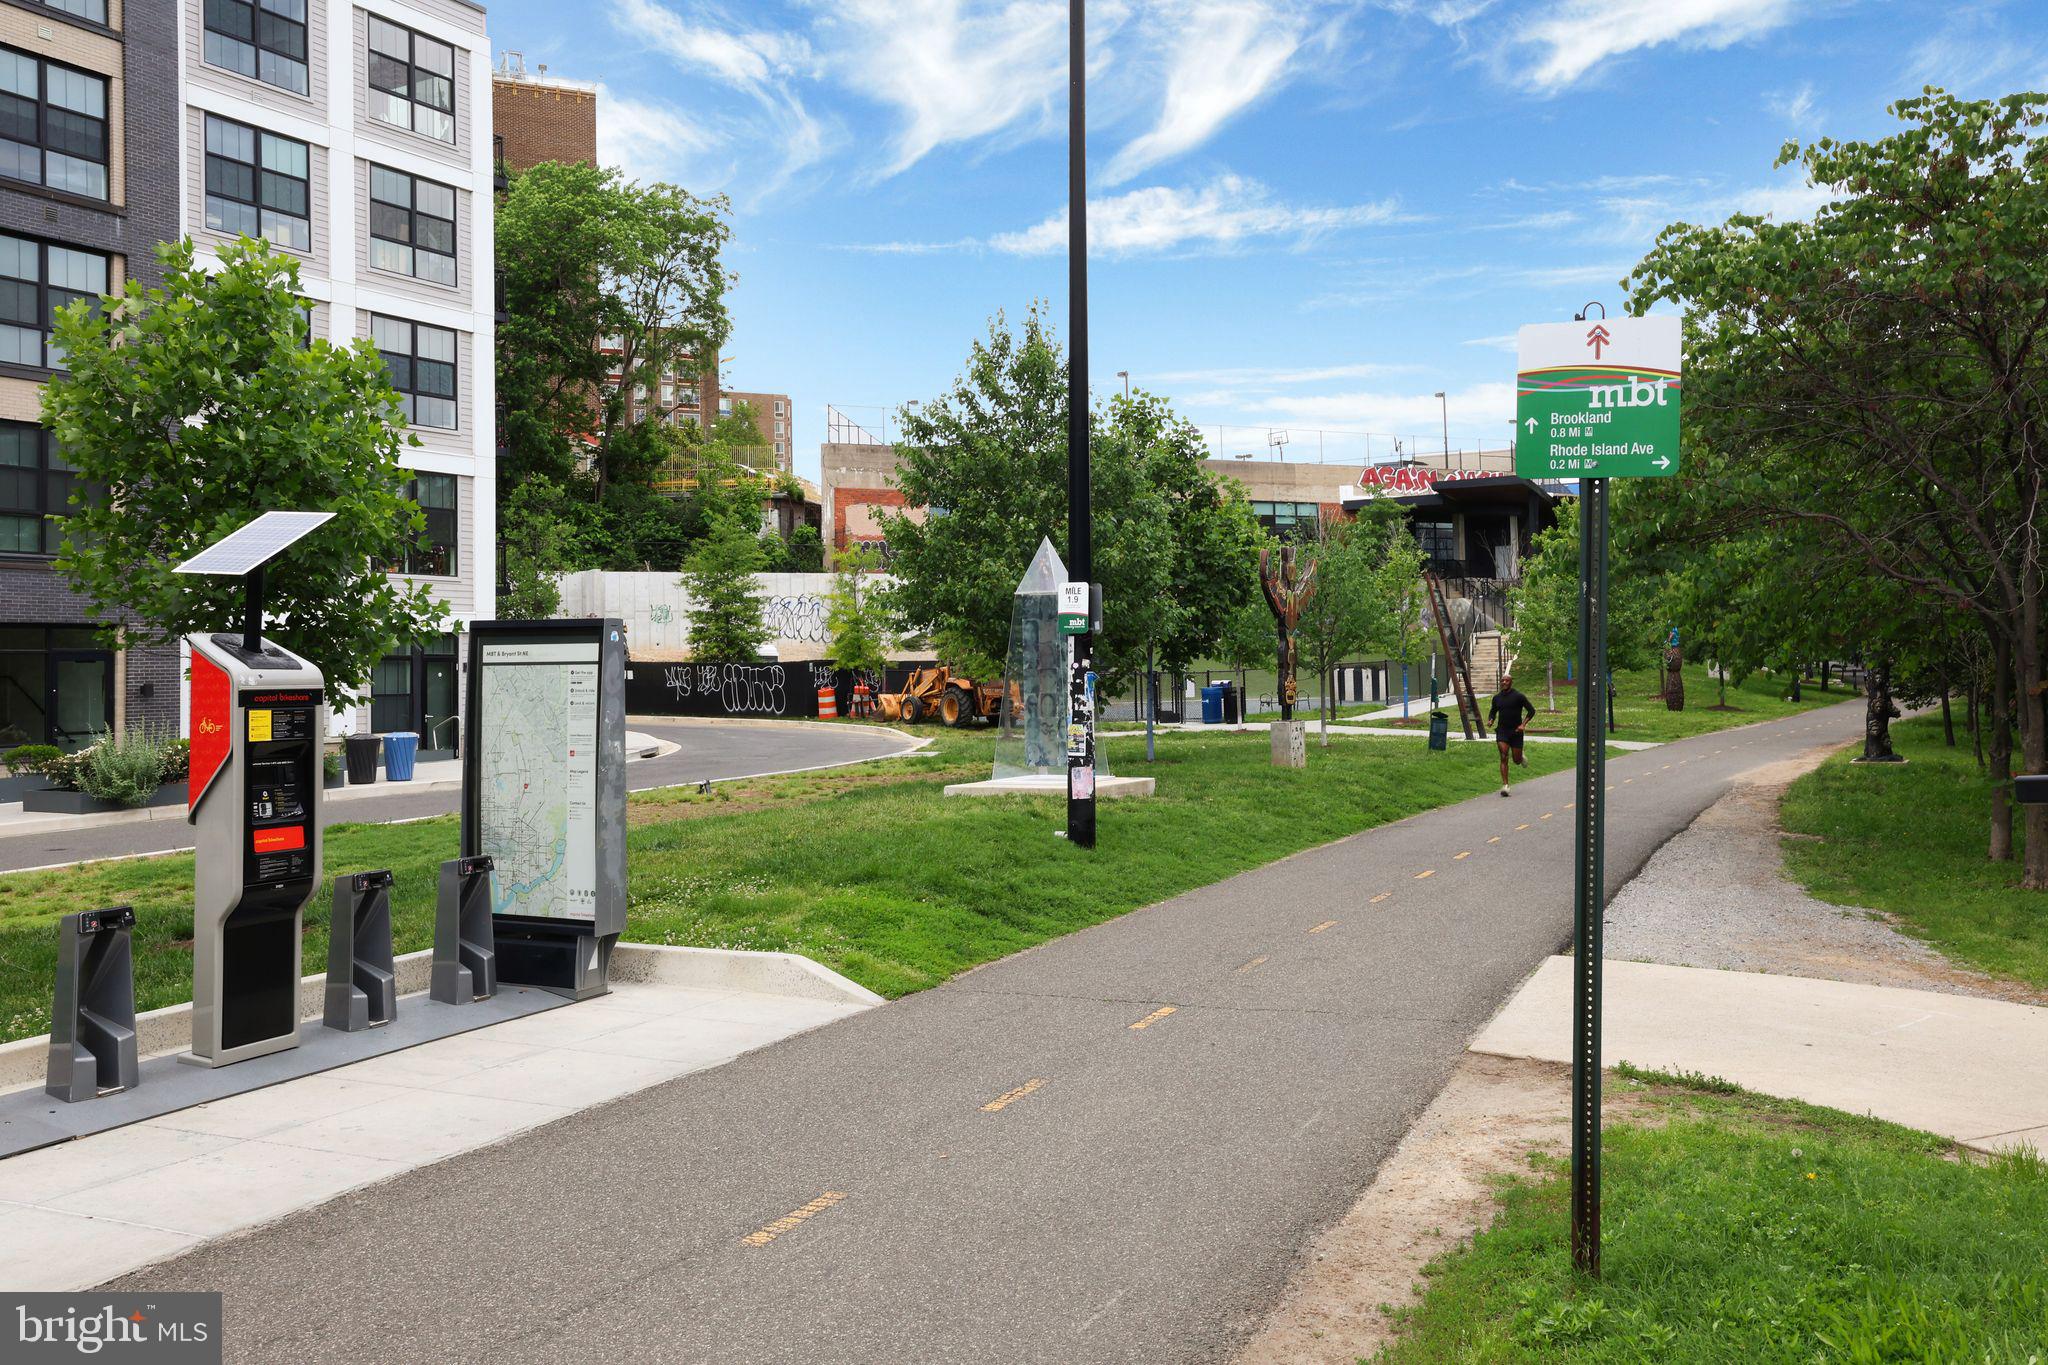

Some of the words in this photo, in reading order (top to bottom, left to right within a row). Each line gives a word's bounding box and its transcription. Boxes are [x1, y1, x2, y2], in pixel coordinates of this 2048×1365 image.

[1589, 376, 1667, 408] mbt
[1551, 411, 1611, 425] Brookland
[1551, 427, 1565, 437] 0.8
[1568, 427, 1580, 437] Mi
[1550, 443, 1587, 456] Rhode
[1592, 443, 1628, 455] Island
[1631, 442, 1654, 455] Ave
[1550, 459, 1565, 469] 0.2
[1568, 458, 1580, 469] Mi
[1065, 587, 1082, 595] MILE
[1069, 617, 1085, 626] mbt
